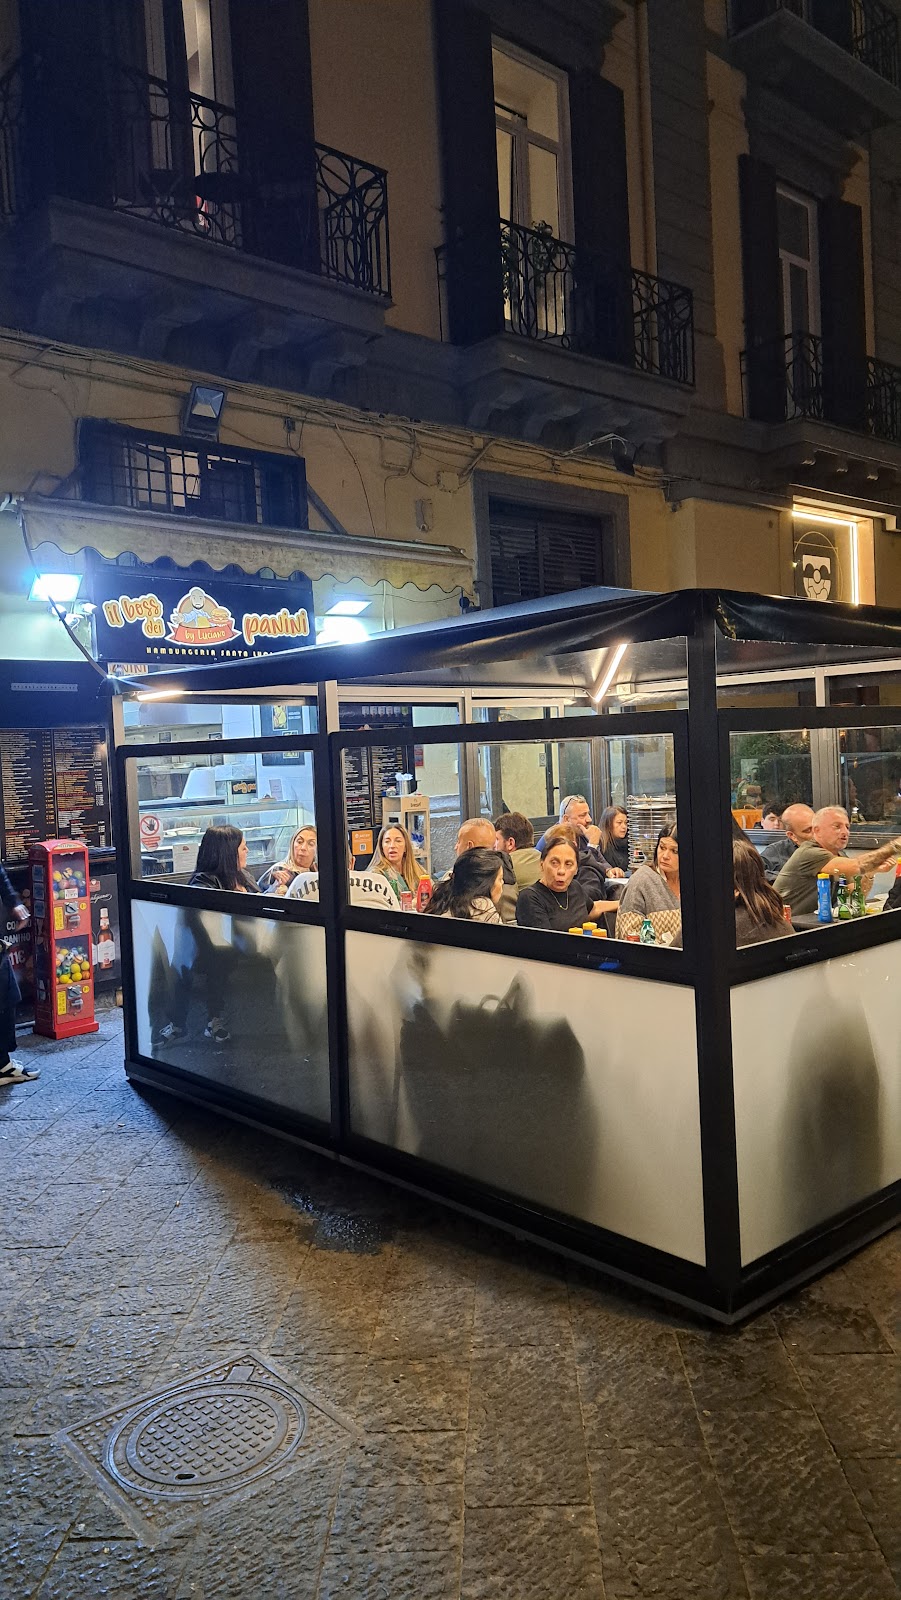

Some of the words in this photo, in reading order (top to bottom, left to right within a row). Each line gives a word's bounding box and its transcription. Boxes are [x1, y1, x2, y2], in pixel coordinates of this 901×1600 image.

[106, 603, 121, 624] il
[122, 597, 161, 620] boss
[146, 619, 162, 635] dei
[245, 611, 307, 642] panini
[185, 630, 195, 642] by
[197, 630, 226, 640] Luciano
[146, 647, 216, 656] HAMBURGERIA
[221, 649, 249, 657] SANTA
